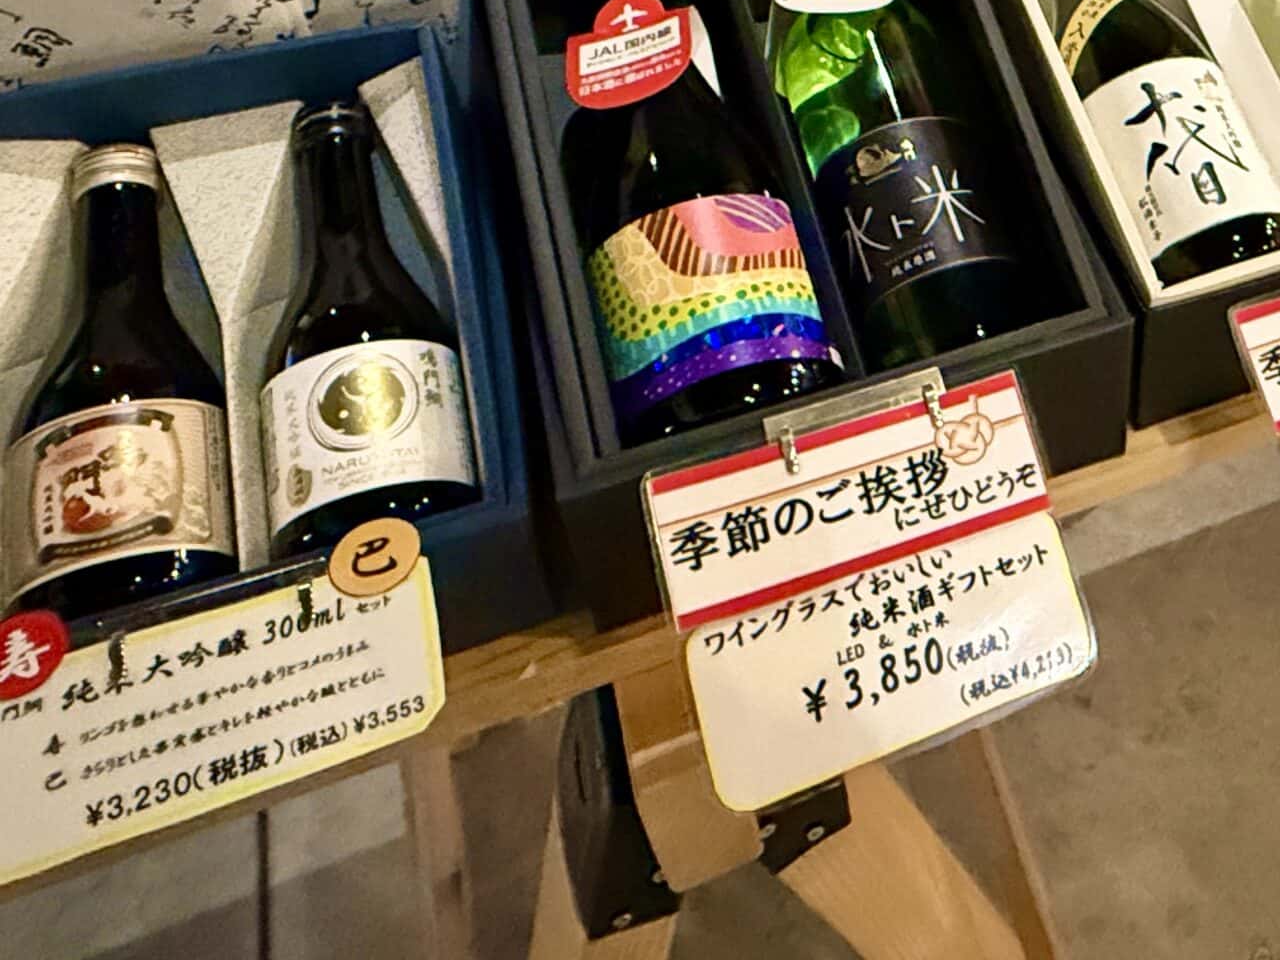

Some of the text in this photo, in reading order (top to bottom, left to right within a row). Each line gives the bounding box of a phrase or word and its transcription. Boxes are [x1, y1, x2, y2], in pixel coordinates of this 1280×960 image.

[669, 447, 949, 572] 季節のご挨拶
[893, 462, 1039, 532] にぜひどうぞ
[703, 549, 953, 657] ワイングラスでおいしい
[836, 642, 865, 666] LED
[906, 610, 951, 638] 水ト米
[848, 543, 1050, 639] 純米酒ギフトセット
[62, 628, 250, 711] 純米大吟醸
[261, 605, 347, 647] 300ml
[354, 593, 392, 615] セット
